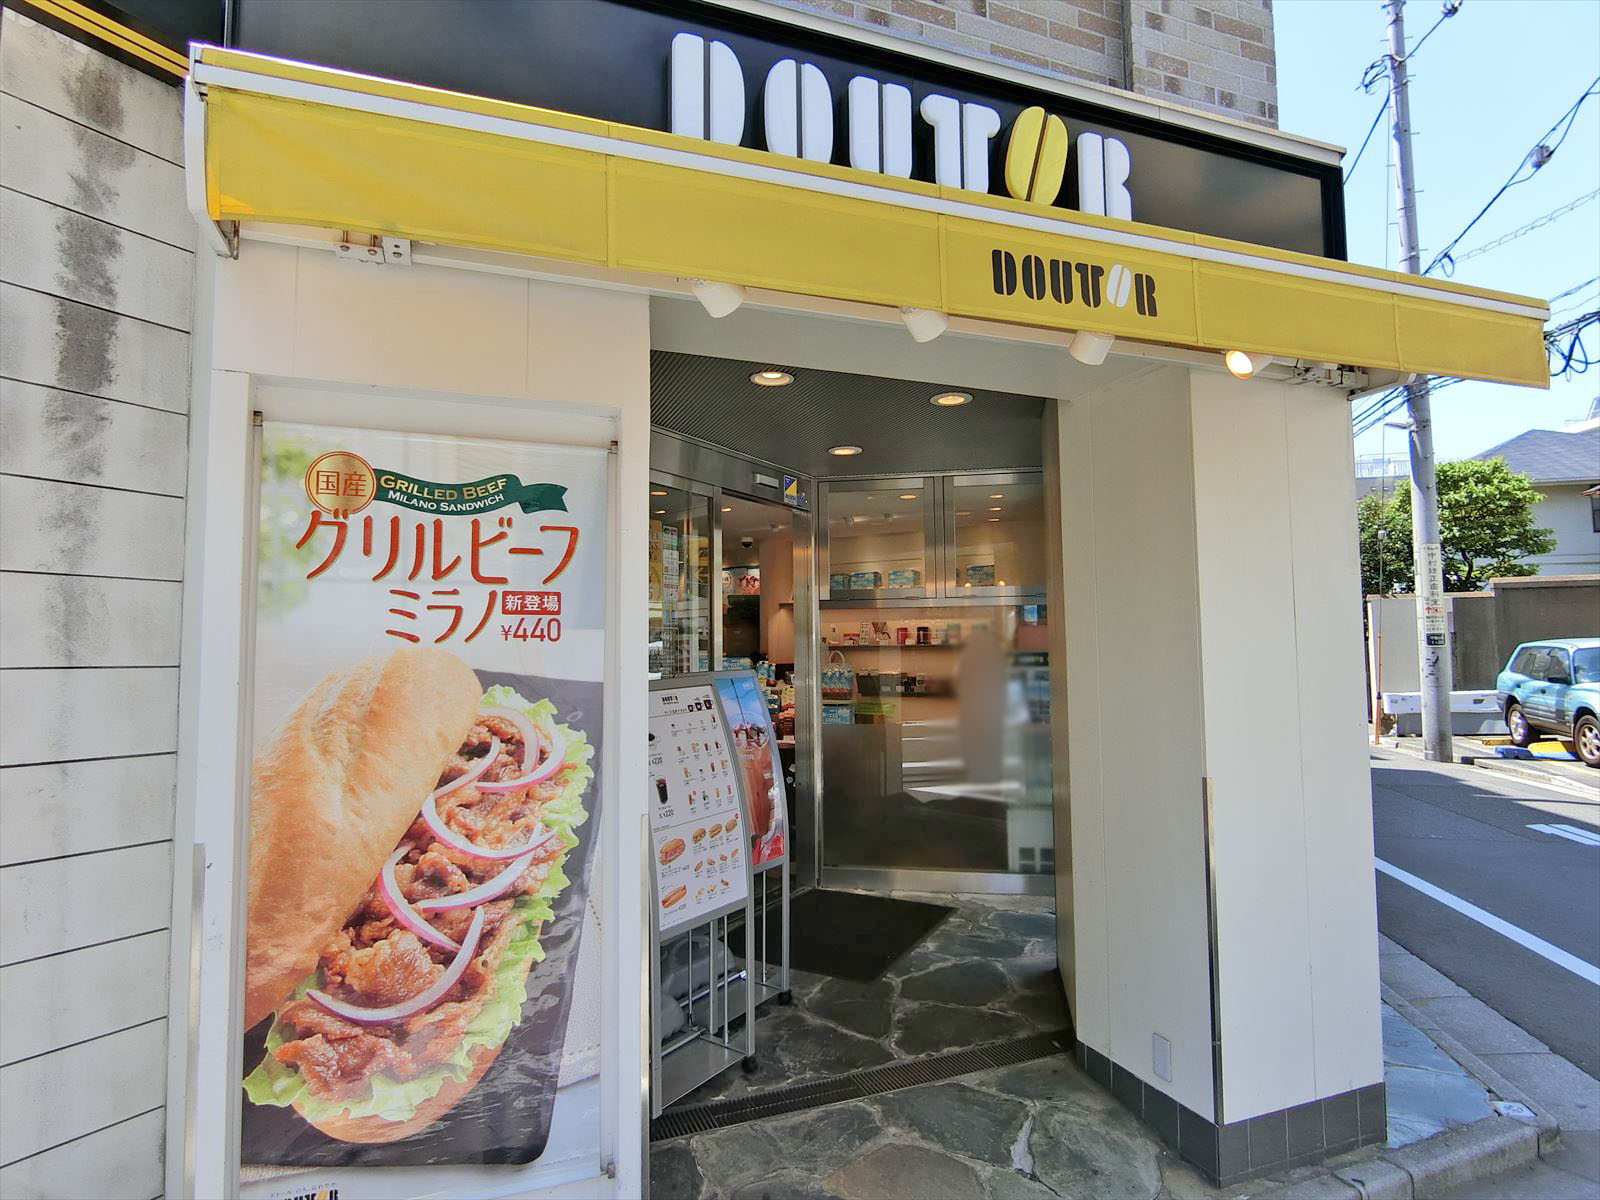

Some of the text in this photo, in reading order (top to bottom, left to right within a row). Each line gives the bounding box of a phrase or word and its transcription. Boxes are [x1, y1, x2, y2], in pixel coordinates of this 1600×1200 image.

[671, 32, 1132, 221] DOUTOR
[992, 249, 1158, 317] DOUTOR
[315, 469, 367, 498] 国産
[379, 474, 507, 501] GRILLED BEEF
[387, 490, 505, 513] MILANO SANDWICH
[295, 508, 580, 585] グリルビーフ
[385, 588, 498, 644] ミラノ
[504, 593, 560, 613] 新登場
[500, 617, 562, 643] ¥440
